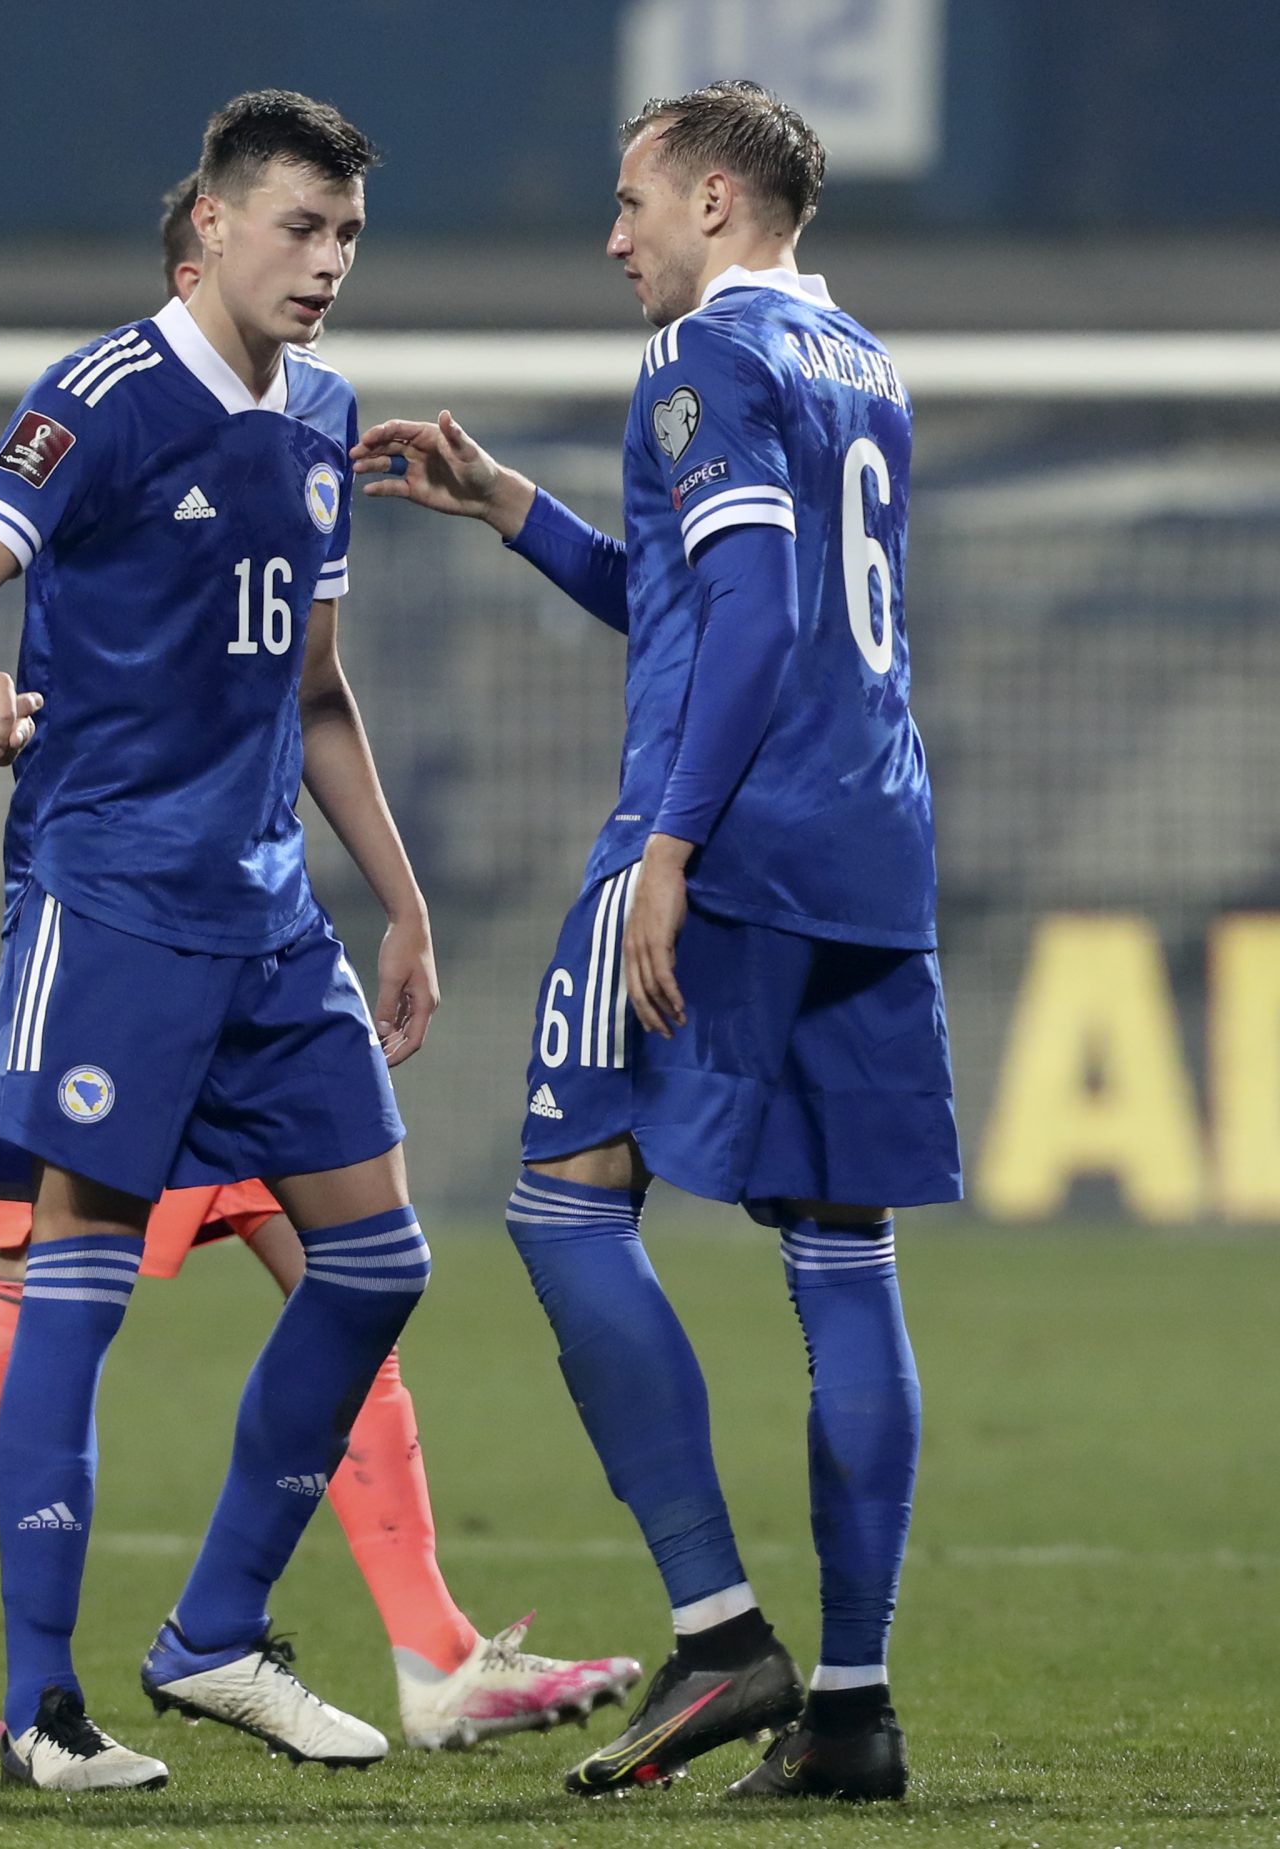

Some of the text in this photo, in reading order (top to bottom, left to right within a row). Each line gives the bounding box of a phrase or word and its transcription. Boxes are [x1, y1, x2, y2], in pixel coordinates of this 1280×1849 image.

[678, 461, 727, 497] RESPECT
[173, 506, 217, 520] adidas
[842, 437, 893, 675] 6
[227, 556, 293, 655] 16
[539, 967, 574, 1069] 6
[529, 1102, 564, 1119] adidas
[17, 1519, 82, 1531] adidas
